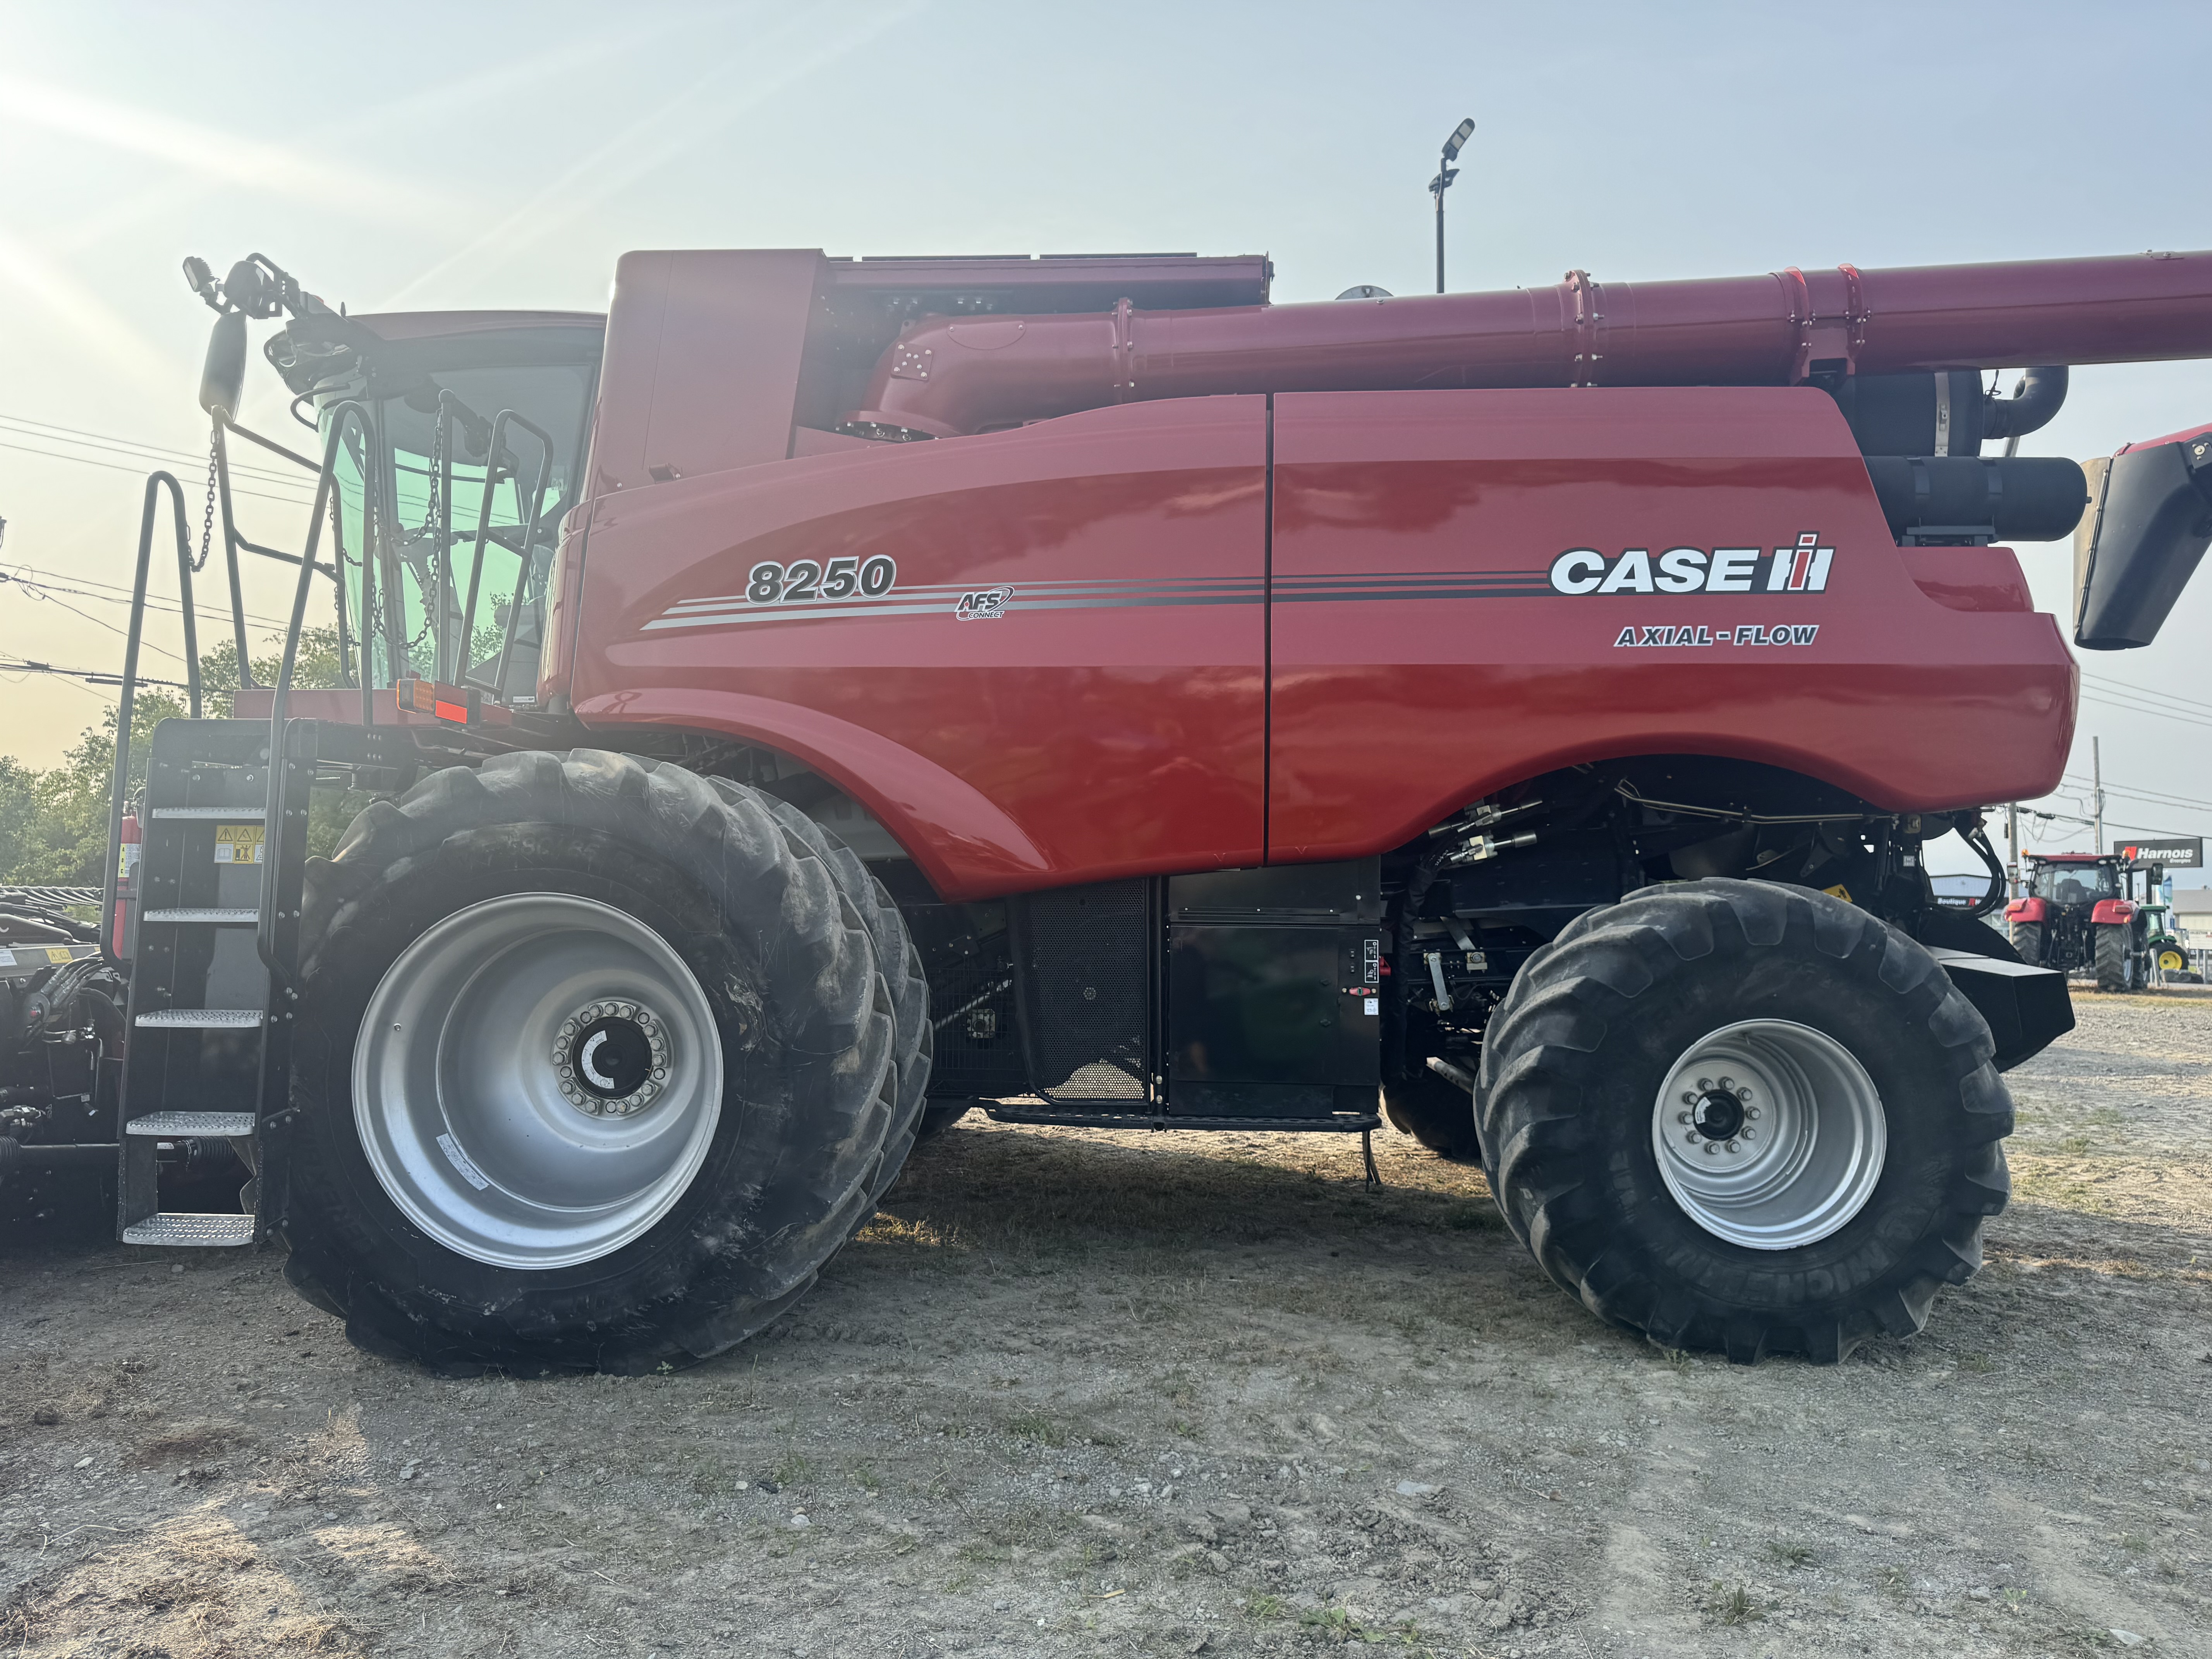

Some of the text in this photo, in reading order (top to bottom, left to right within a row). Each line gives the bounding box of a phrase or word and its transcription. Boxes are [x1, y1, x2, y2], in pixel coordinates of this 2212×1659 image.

[744, 554, 897, 605] 8250
[1550, 548, 1761, 594] CASE
[955, 591, 1002, 611] AFS
[1613, 625, 1819, 647] AXIAL-FLOW
[2137, 848, 2193, 859] Harnois
[1937, 897, 1966, 906] Boutique
